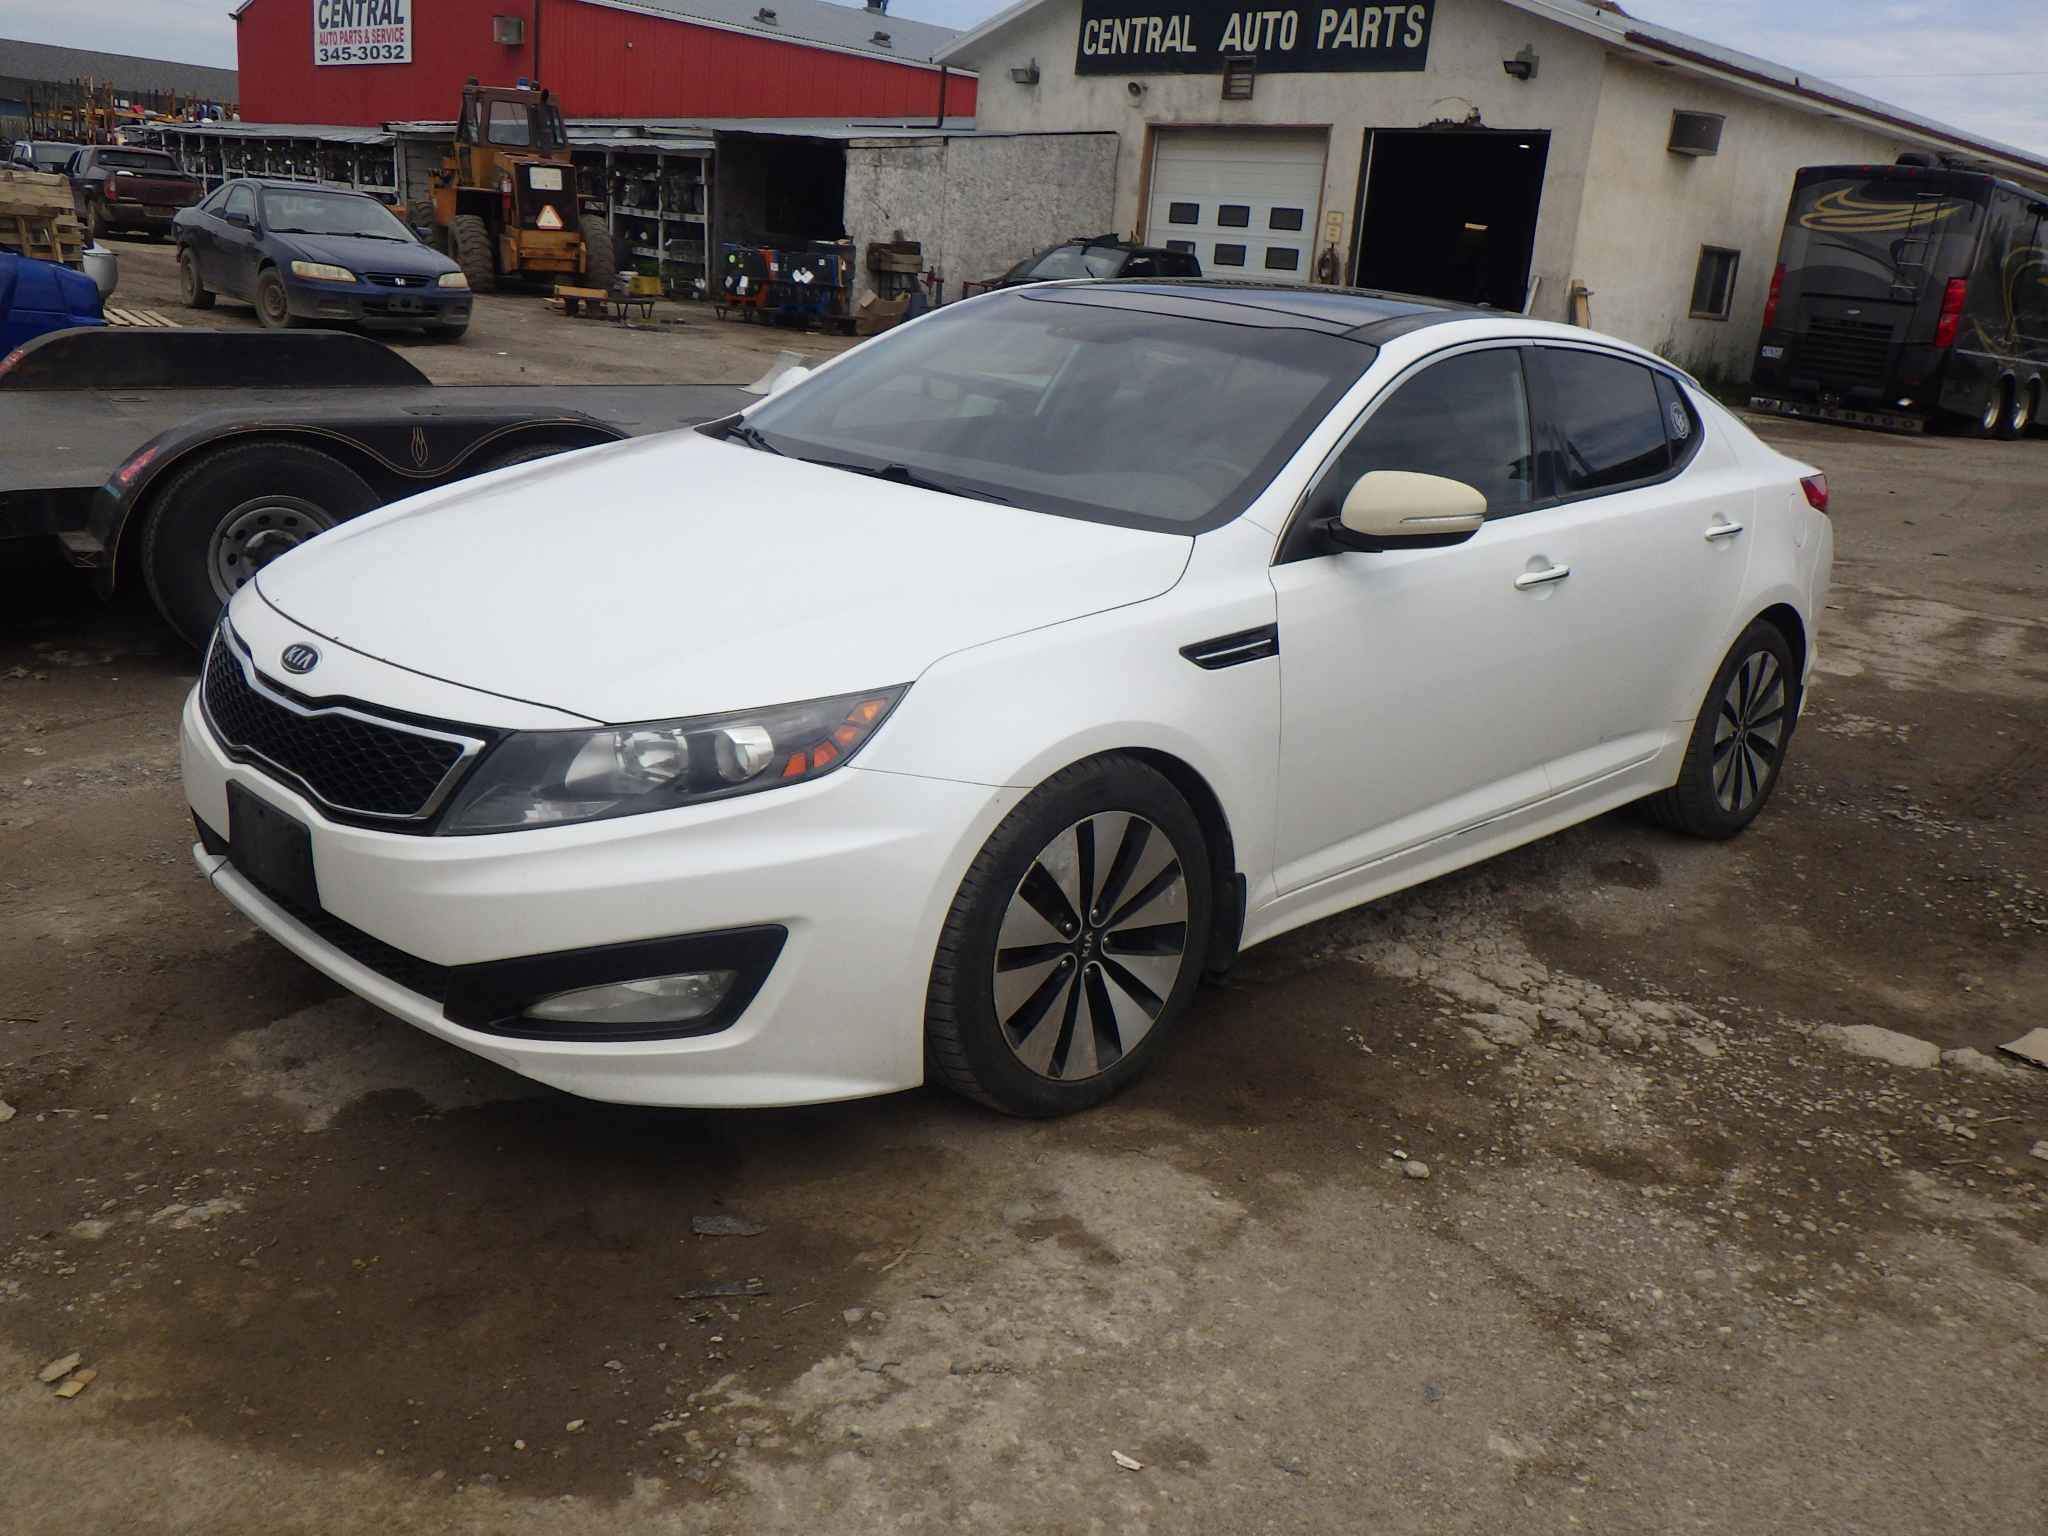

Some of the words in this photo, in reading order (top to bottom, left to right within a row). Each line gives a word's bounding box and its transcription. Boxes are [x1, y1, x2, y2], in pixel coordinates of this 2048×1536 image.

[319, 0, 405, 29] CENTRAL
[319, 31, 338, 47] AUTO
[339, 29, 362, 45] PARTS
[364, 29, 370, 43] &
[371, 27, 405, 43] SERVICE
[1083, 15, 1197, 55] CENTRAL
[1218, 10, 1298, 52] AUTO
[1317, 5, 1425, 49] PARTS
[319, 45, 405, 62] 345-3032
[284, 645, 314, 669] KIA
